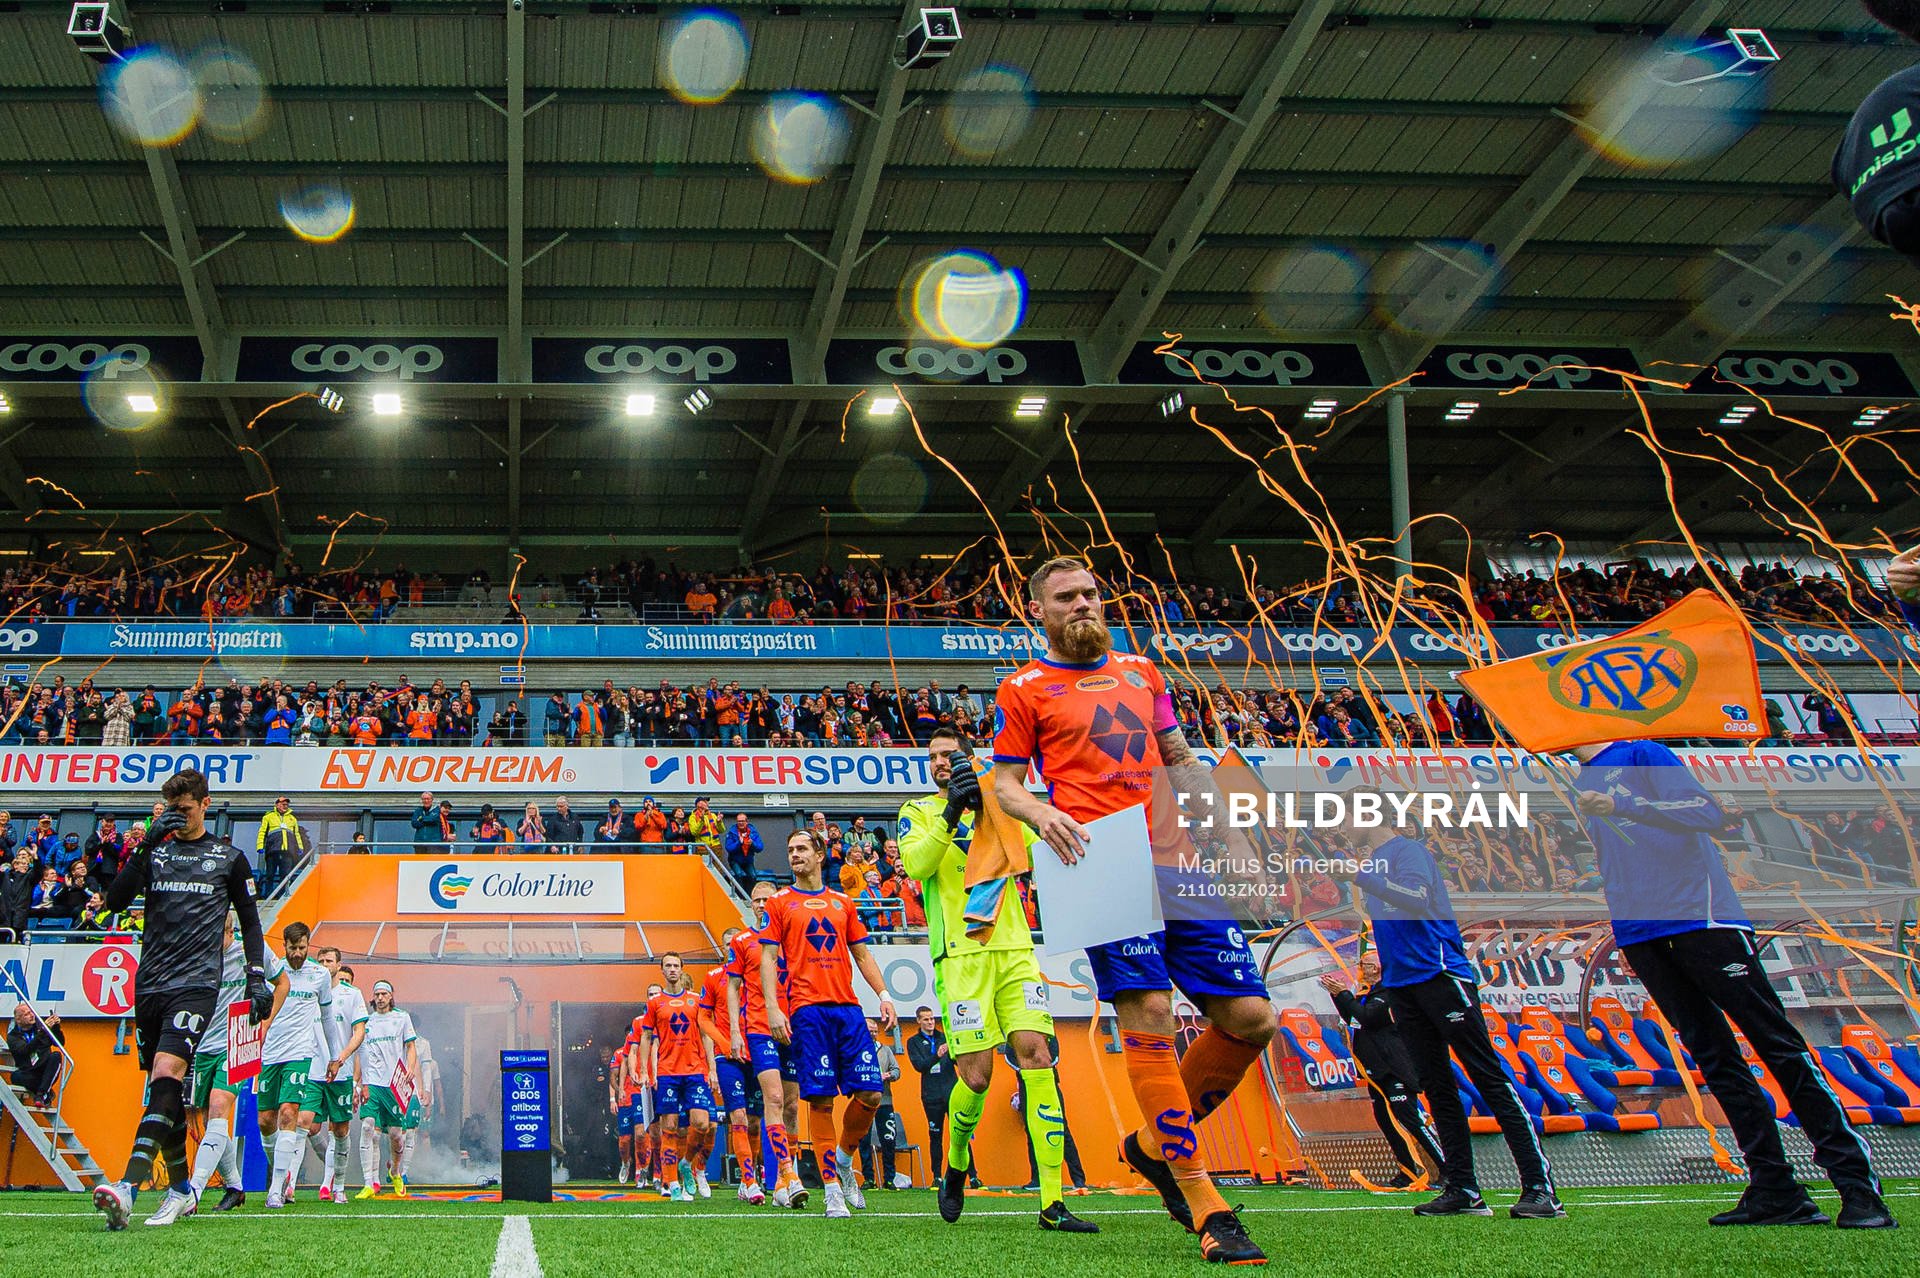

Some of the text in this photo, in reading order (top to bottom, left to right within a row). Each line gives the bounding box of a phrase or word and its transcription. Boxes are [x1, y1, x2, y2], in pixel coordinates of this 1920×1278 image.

[1851, 133, 1920, 195] unisp
[1, 343, 150, 379] coop
[292, 344, 443, 379] coop
[585, 345, 736, 381] coop
[876, 346, 1027, 383] coop
[1164, 349, 1314, 386] coop
[1446, 352, 1592, 389] coop
[1718, 357, 1859, 394] coop
[110, 624, 282, 654] Sunnmørsposten
[410, 631, 518, 652] smp.no
[645, 626, 817, 656] Sunnmørsposten
[942, 633, 1049, 655] smp.no
[1151, 633, 1233, 656] coop
[1282, 633, 1363, 656] coop
[1783, 634, 1860, 656] coop
[1724, 722, 1758, 732] OBOS
[1, 753, 253, 783] INTERSPORT
[378, 755, 564, 783] NORHEIM
[686, 755, 931, 786] INTERSPORT
[1233, 969, 1244, 981] 5
[861, 1074, 871, 1082] 22
[511, 1090, 541, 1100] OBOS
[511, 1102, 541, 1112] altibox
[514, 1123, 539, 1132] coop
[1218, 1178, 1253, 1186] SELECT
